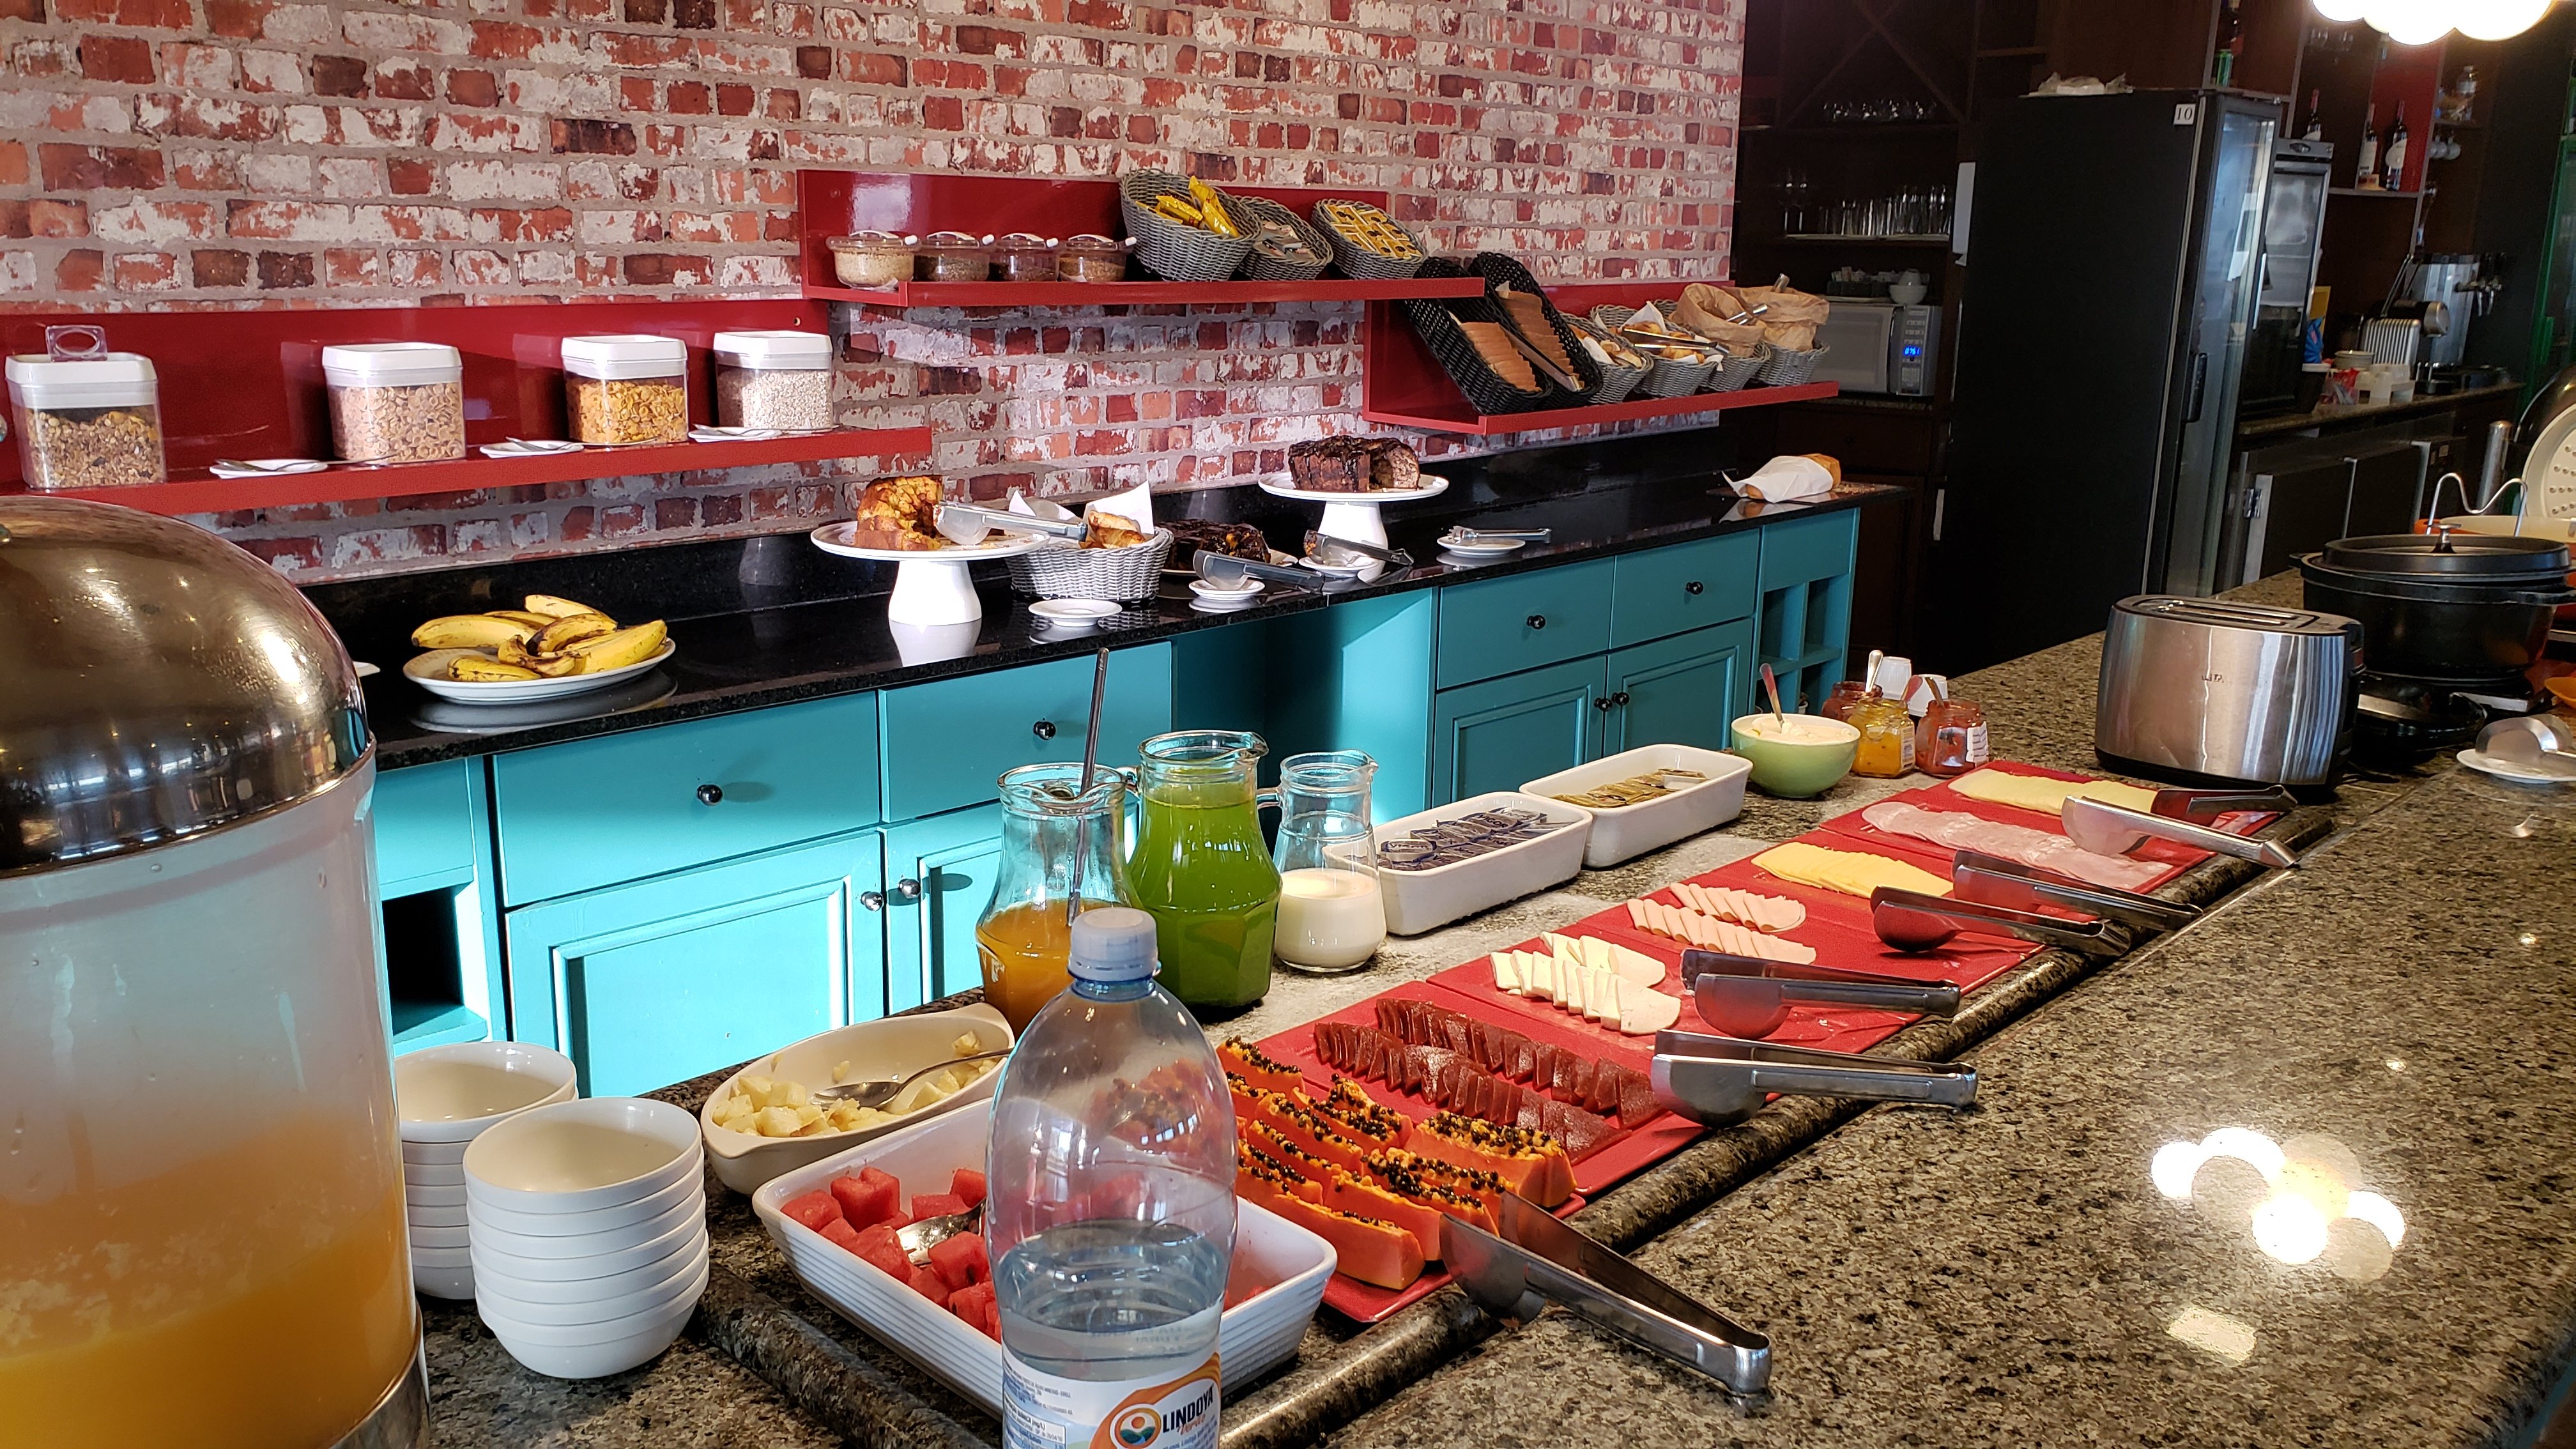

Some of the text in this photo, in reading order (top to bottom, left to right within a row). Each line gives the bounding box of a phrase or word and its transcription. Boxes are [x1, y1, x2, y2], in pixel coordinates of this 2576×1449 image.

[2177, 107, 2193, 120] 10
[1477, 815, 1508, 828] VIGOR
[1163, 1384, 1214, 1434] LINDOYA
